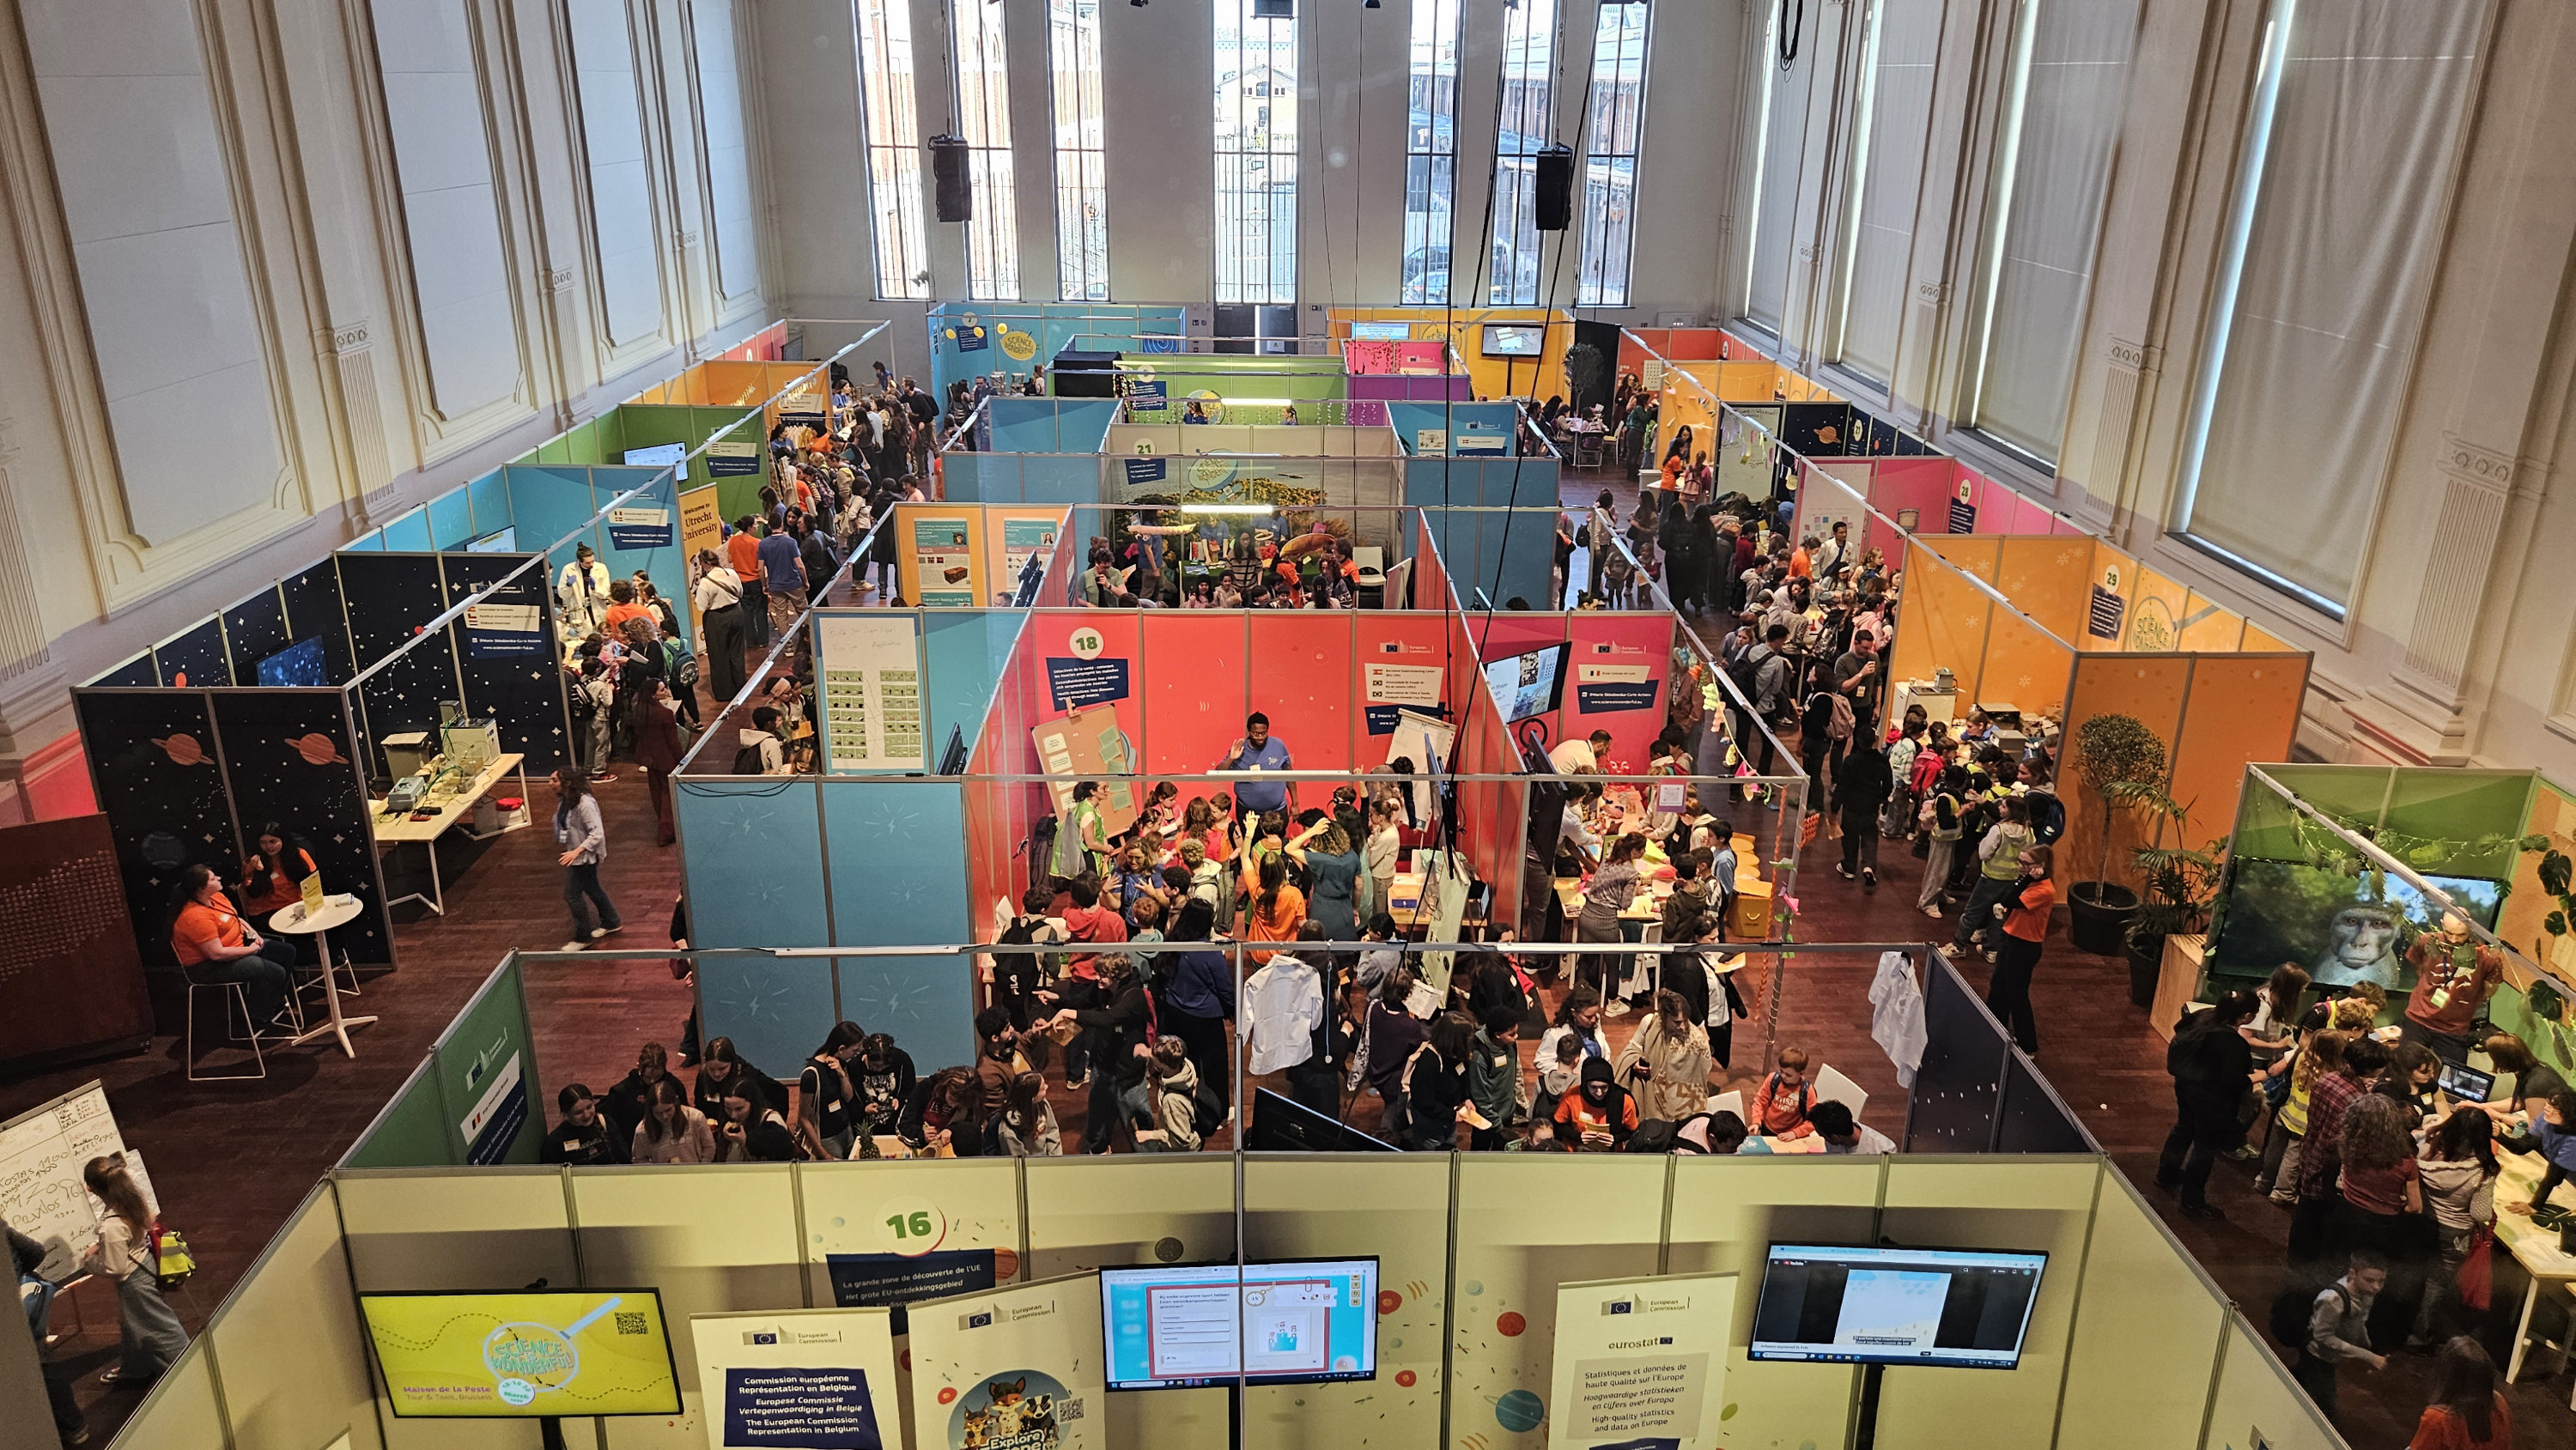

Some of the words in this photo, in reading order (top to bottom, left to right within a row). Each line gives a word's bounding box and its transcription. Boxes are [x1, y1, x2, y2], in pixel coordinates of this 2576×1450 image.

[1137, 444, 1151, 454] 21
[1961, 486, 1968, 497] 28
[684, 505, 705, 515] Welcome
[685, 512, 713, 527] Utrecht
[2107, 572, 2117, 585] 29
[1076, 636, 1097, 651] 18
[886, 1211, 932, 1239] 16
[854, 1278, 880, 1289] grande
[902, 1273, 911, 1282] de
[912, 1268, 954, 1280] découverte
[956, 1266, 965, 1275] de
[966, 1264, 981, 1273] l'UE
[860, 1291, 880, 1300] grote
[882, 1279, 963, 1297] EU-ontdekkingsgebied
[1012, 1304, 1042, 1315] European
[1012, 1309, 1051, 1321] Commission
[494, 1338, 562, 1359] SCIENCE
[1608, 1337, 1659, 1350] eurostat
[489, 1352, 574, 1374] WONDERFUL
[1584, 1370, 1631, 1380] Statistiques
[1643, 1364, 1675, 1374] données
[744, 1376, 797, 1386] Commission
[799, 1374, 849, 1385] européenne
[1585, 1380, 1607, 1389] haute
[1609, 1378, 1637, 1387] qualité
[1652, 1374, 1685, 1383] l'Europe
[739, 1385, 805, 1395] Représentation
[819, 1384, 857, 1392] Belgique
[1583, 1391, 1637, 1403] Hoogwaardige
[1639, 1386, 1685, 1397] statistieken
[756, 1398, 795, 1407] Europese
[798, 1396, 843, 1404] Commissie
[1603, 1400, 1626, 1410] cijfers
[1629, 1398, 1644, 1407] over
[1647, 1397, 1674, 1405] Europa
[739, 1405, 824, 1415] Vertegenwoordiging
[1591, 1413, 1637, 1423] High-quality
[1639, 1409, 1675, 1417] statistics
[764, 1417, 805, 1427] European
[806, 1417, 858, 1425] Commission
[1641, 1418, 1668, 1428] Europe
[747, 1427, 812, 1436] Representation
[824, 1425, 860, 1434] Belgium
[990, 1431, 1041, 1450] Explore
